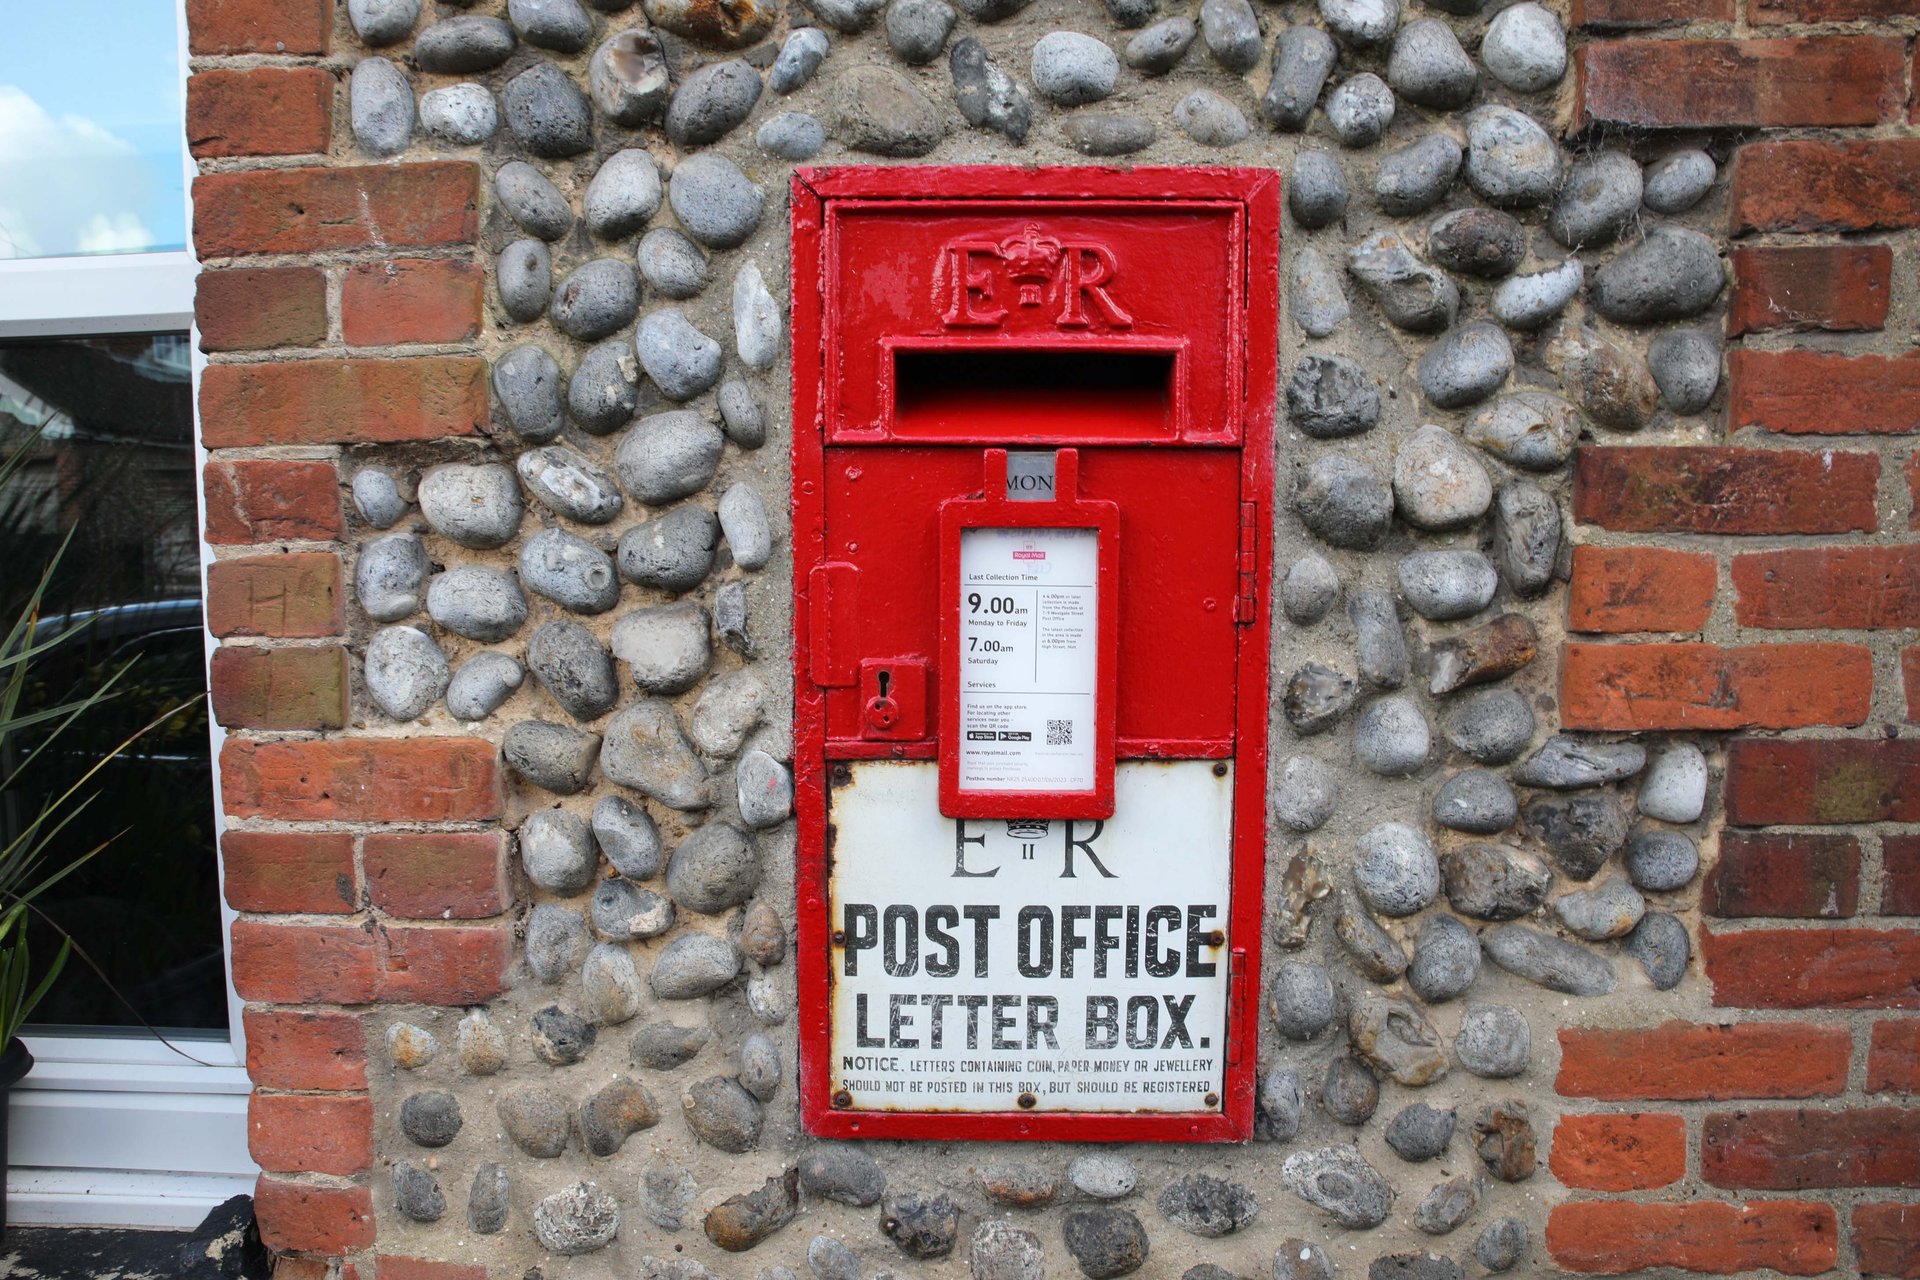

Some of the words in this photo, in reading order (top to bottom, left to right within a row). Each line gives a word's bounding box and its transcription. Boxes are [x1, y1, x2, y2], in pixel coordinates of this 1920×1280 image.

[941, 240, 1008, 327] E
[1056, 240, 1133, 328] R
[1006, 475, 1053, 490] MON
[968, 592, 1028, 614] 9.00am
[1006, 620, 1028, 628] Friday
[968, 637, 1014, 652] 7.00am
[968, 657, 998, 666] Saturday
[1059, 819, 1119, 878] R
[844, 903, 1000, 978] POST
[1017, 904, 1217, 979] OFFICE
[856, 993, 1059, 1050] LETTER
[1084, 994, 1210, 1050] BOX.
[842, 1056, 905, 1072] NOTICE.
[910, 1060, 955, 1073] LETTERS
[960, 1060, 1022, 1073] CONTAINING
[1057, 1060, 1089, 1073] PAPER
[1093, 1060, 1130, 1073] MONEY
[1134, 1060, 1148, 1072] OR
[1153, 1059, 1213, 1072] JEWELLERY
[842, 1079, 880, 1092] SHOULD
[885, 1080, 906, 1092] NOT
[910, 1081, 922, 1093] BE
[927, 1081, 967, 1093] POSTED
[972, 1082, 984, 1094] IN
[988, 1082, 1012, 1094] THIS
[1018, 1082, 1046, 1096] BOX,
[1050, 1081, 1070, 1093] BUT
[1076, 1081, 1118, 1093] SHOULD
[1124, 1081, 1138, 1093] BE
[1143, 1080, 1210, 1093] REGISTERED
